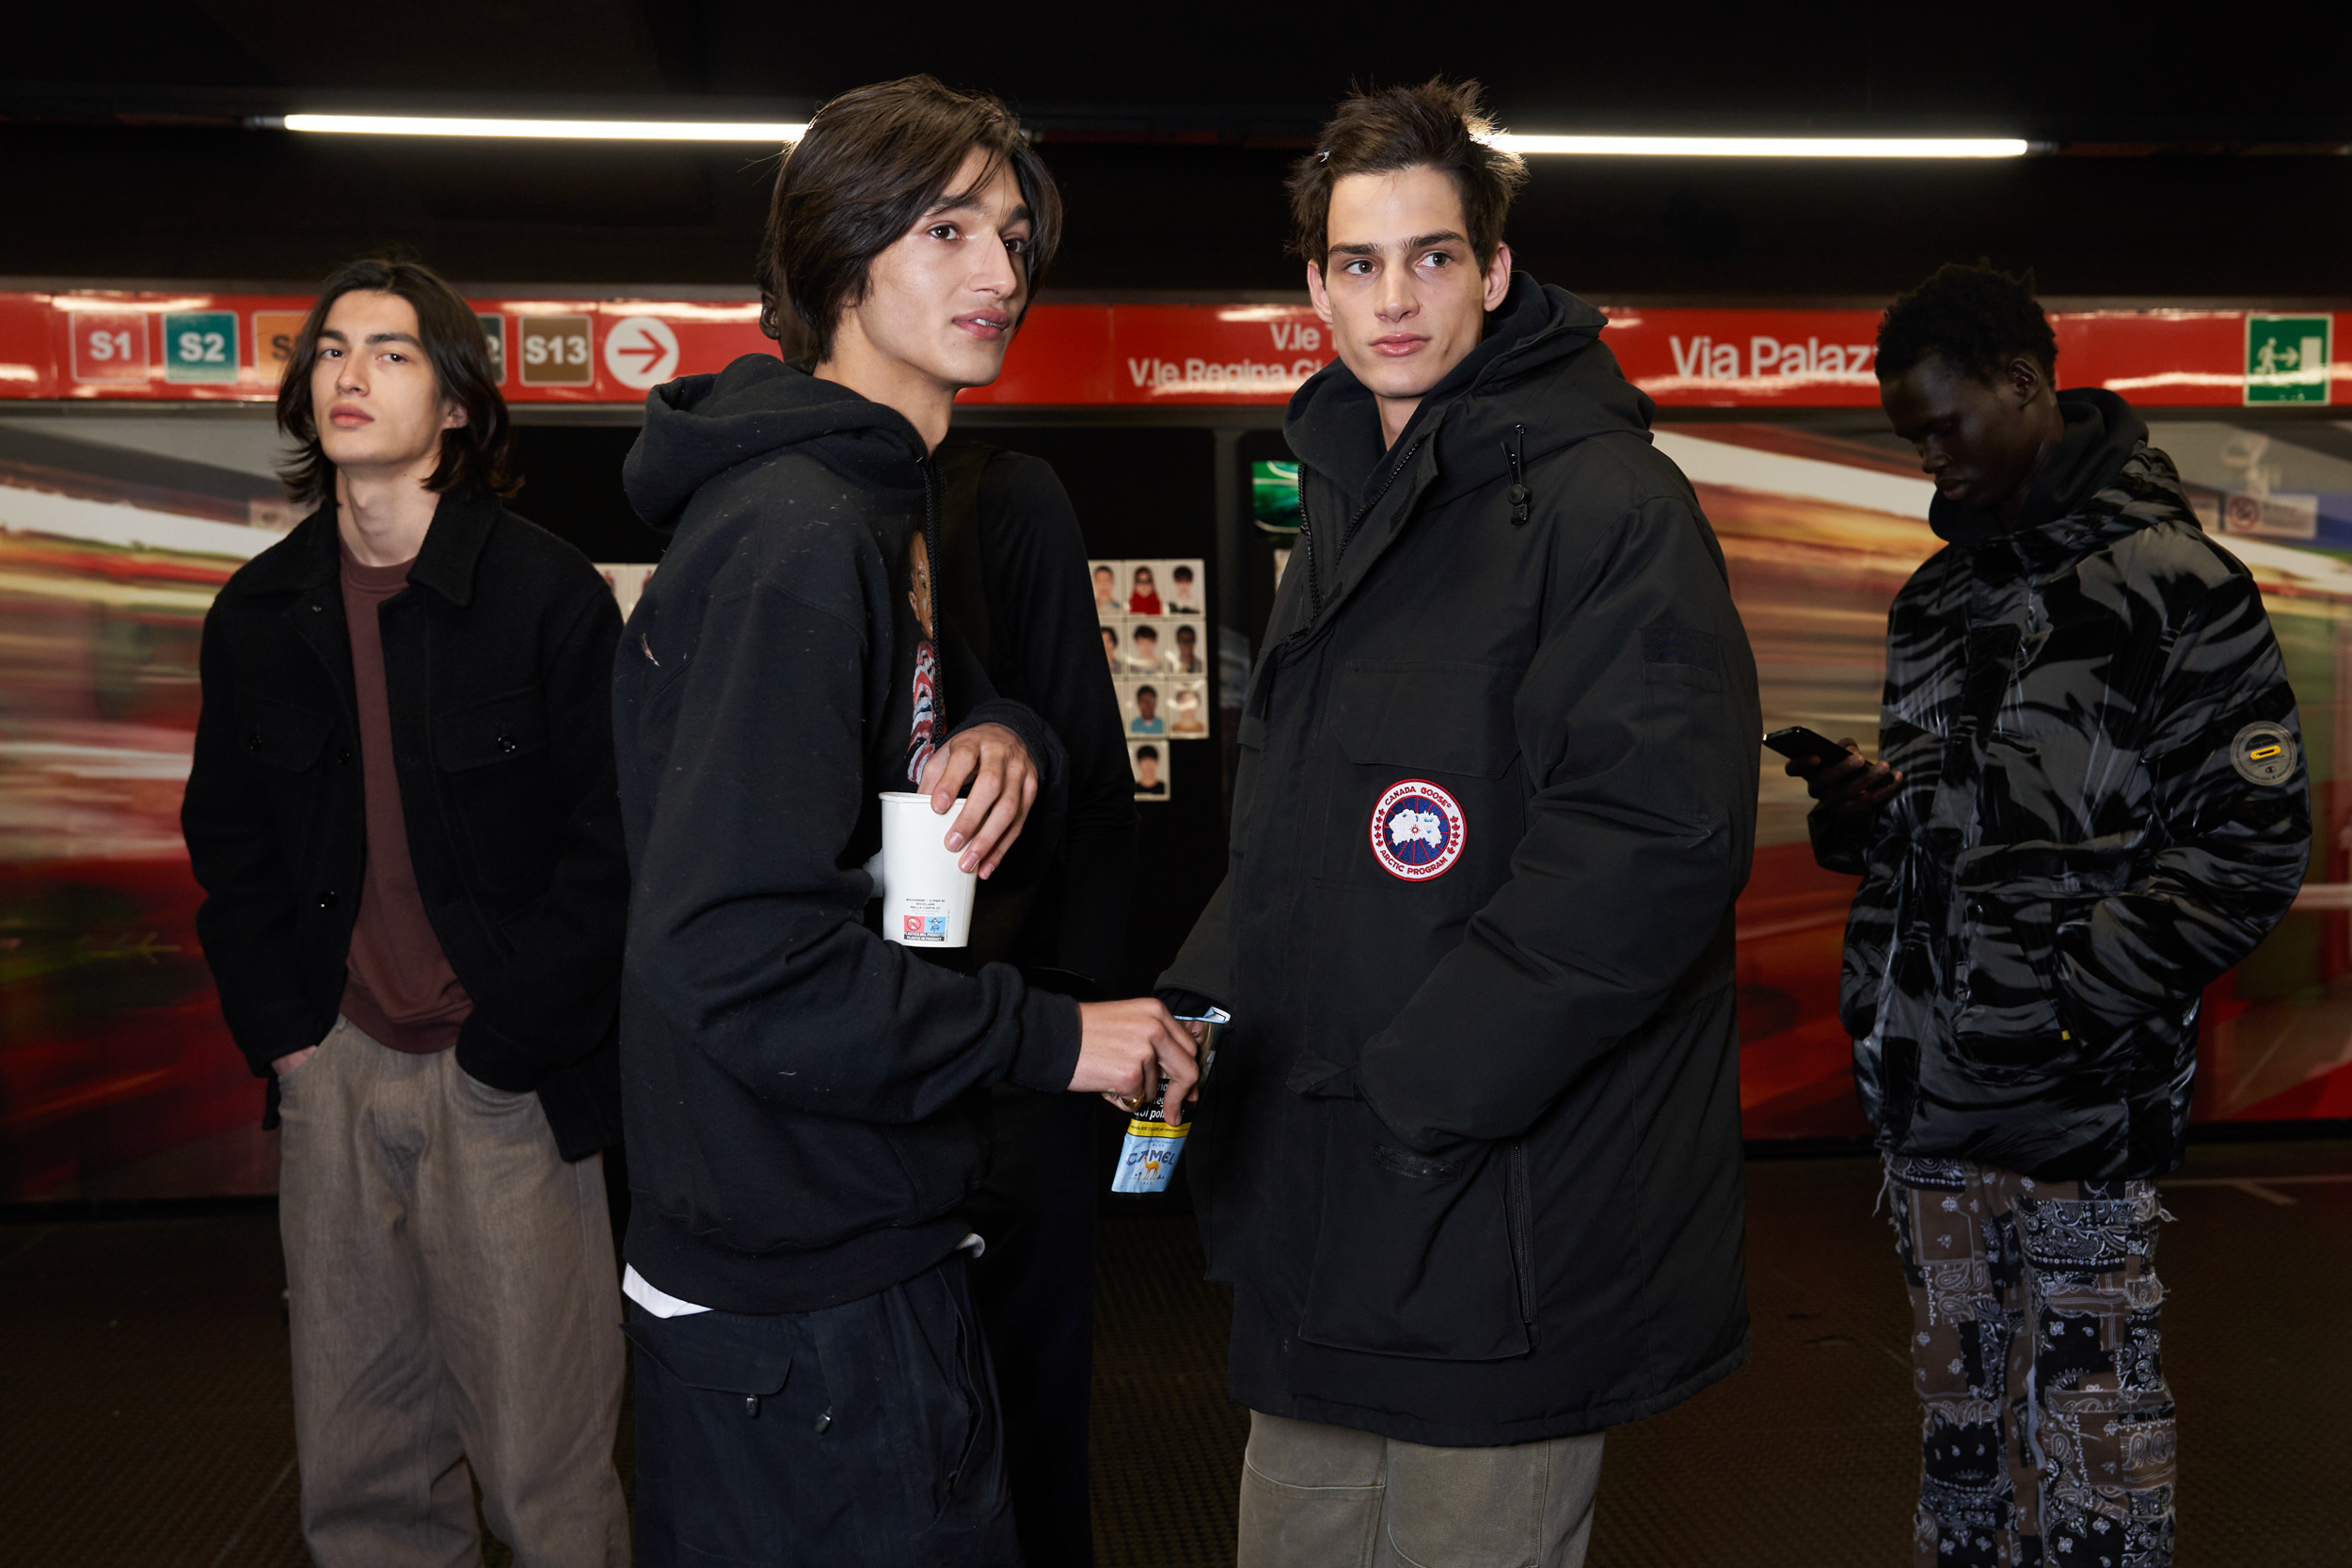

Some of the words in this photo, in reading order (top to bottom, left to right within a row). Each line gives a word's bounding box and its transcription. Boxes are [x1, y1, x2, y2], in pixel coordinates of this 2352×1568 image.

[89, 330, 131, 360] S1
[179, 332, 225, 363] S2
[525, 335, 587, 365] S13
[1270, 324, 1320, 351] V.le
[1668, 336, 1740, 379] Via
[1750, 336, 1880, 380] Palaz
[1184, 357, 1287, 391] Regina
[1385, 786, 1416, 806] CANADA
[1380, 849, 1405, 872] ARCTIC
[1406, 856, 1448, 876] PROGRAM
[1125, 1149, 1175, 1166] CAMEL
